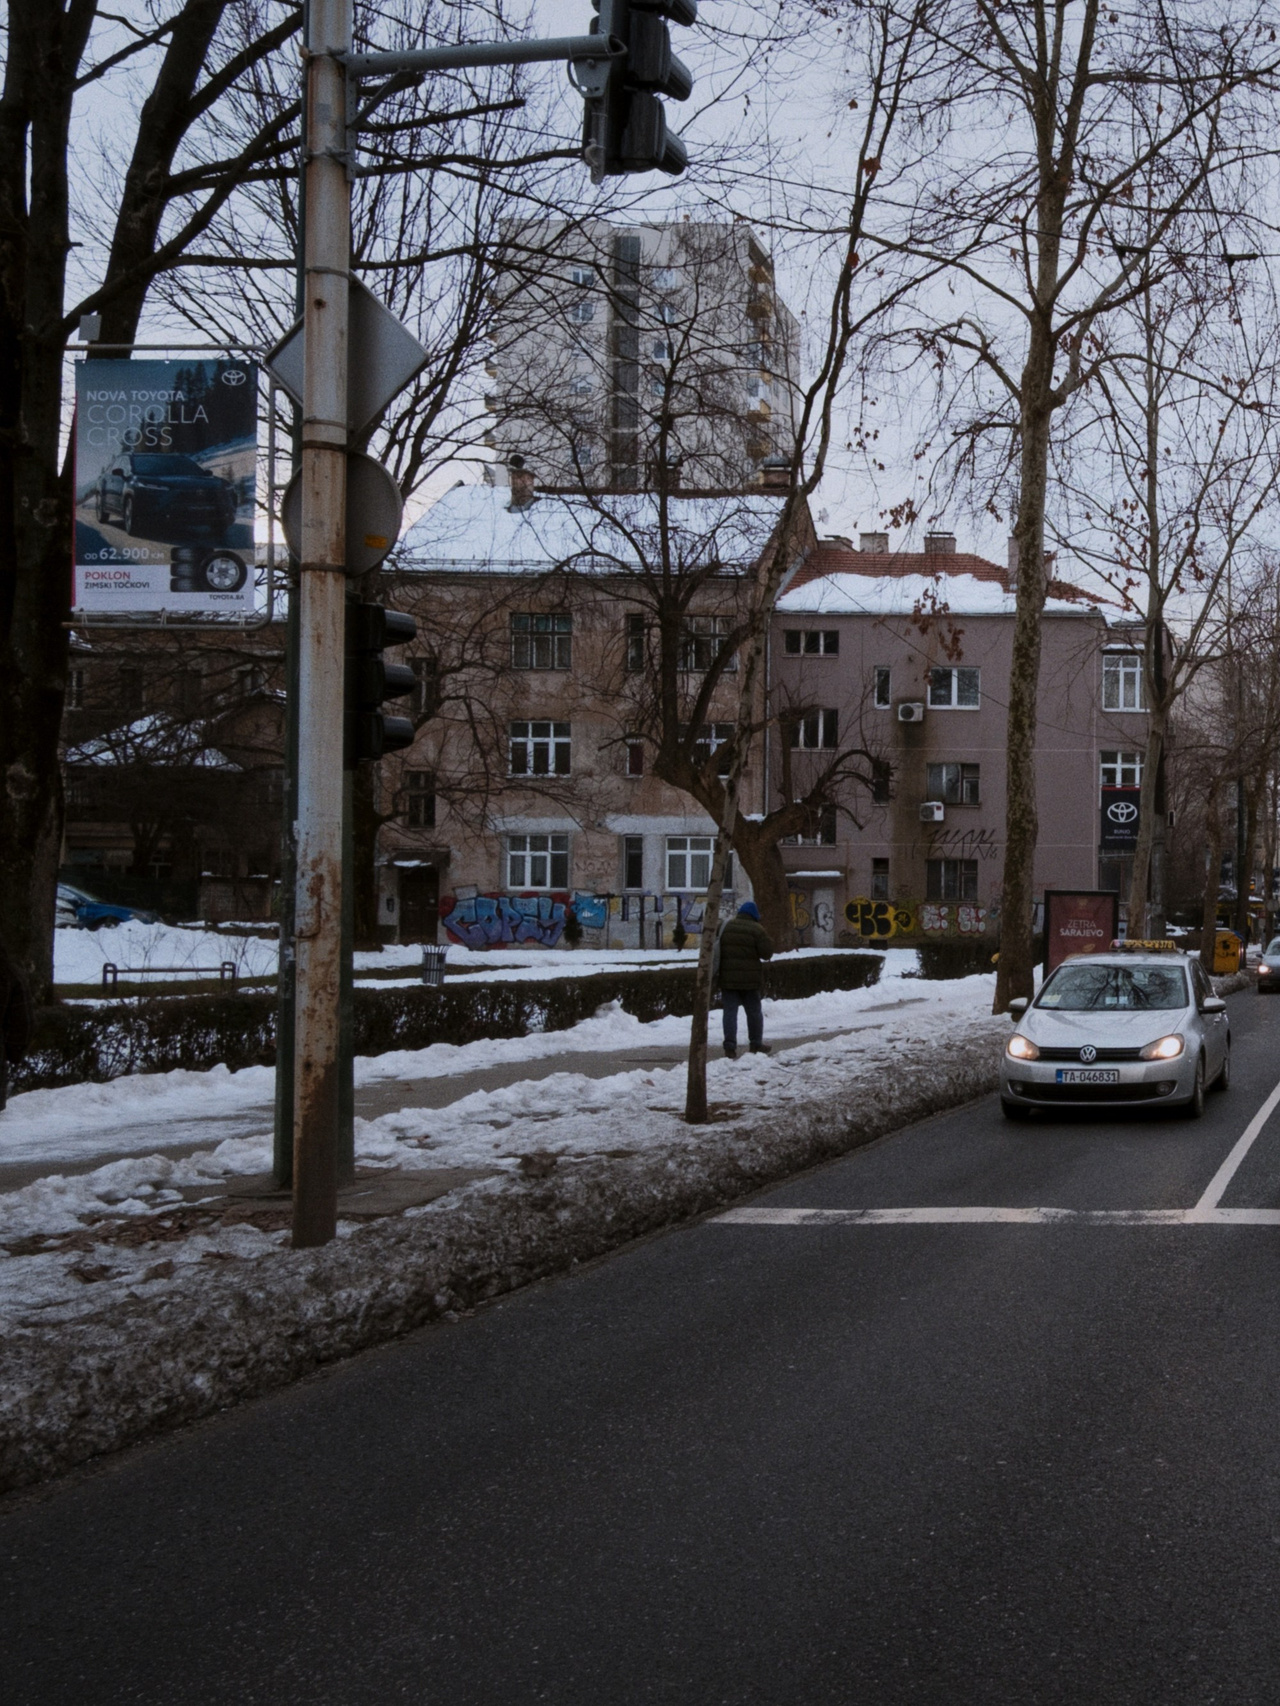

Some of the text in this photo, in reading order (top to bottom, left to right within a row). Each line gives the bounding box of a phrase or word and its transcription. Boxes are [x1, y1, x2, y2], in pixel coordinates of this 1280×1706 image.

[86, 390, 185, 401] NOVA TOYOTA
[87, 404, 209, 424] COROLLA
[87, 426, 173, 446] CROSS
[84, 552, 98, 560] OD
[99, 547, 150, 560] 62.900
[84, 571, 131, 580] POKLON
[115, 580, 150, 589] TOČKOVI
[1067, 919, 1097, 928] ZETRA
[1059, 928, 1105, 937] SARAJEVO
[1063, 1072, 1117, 1082] TA-046831
